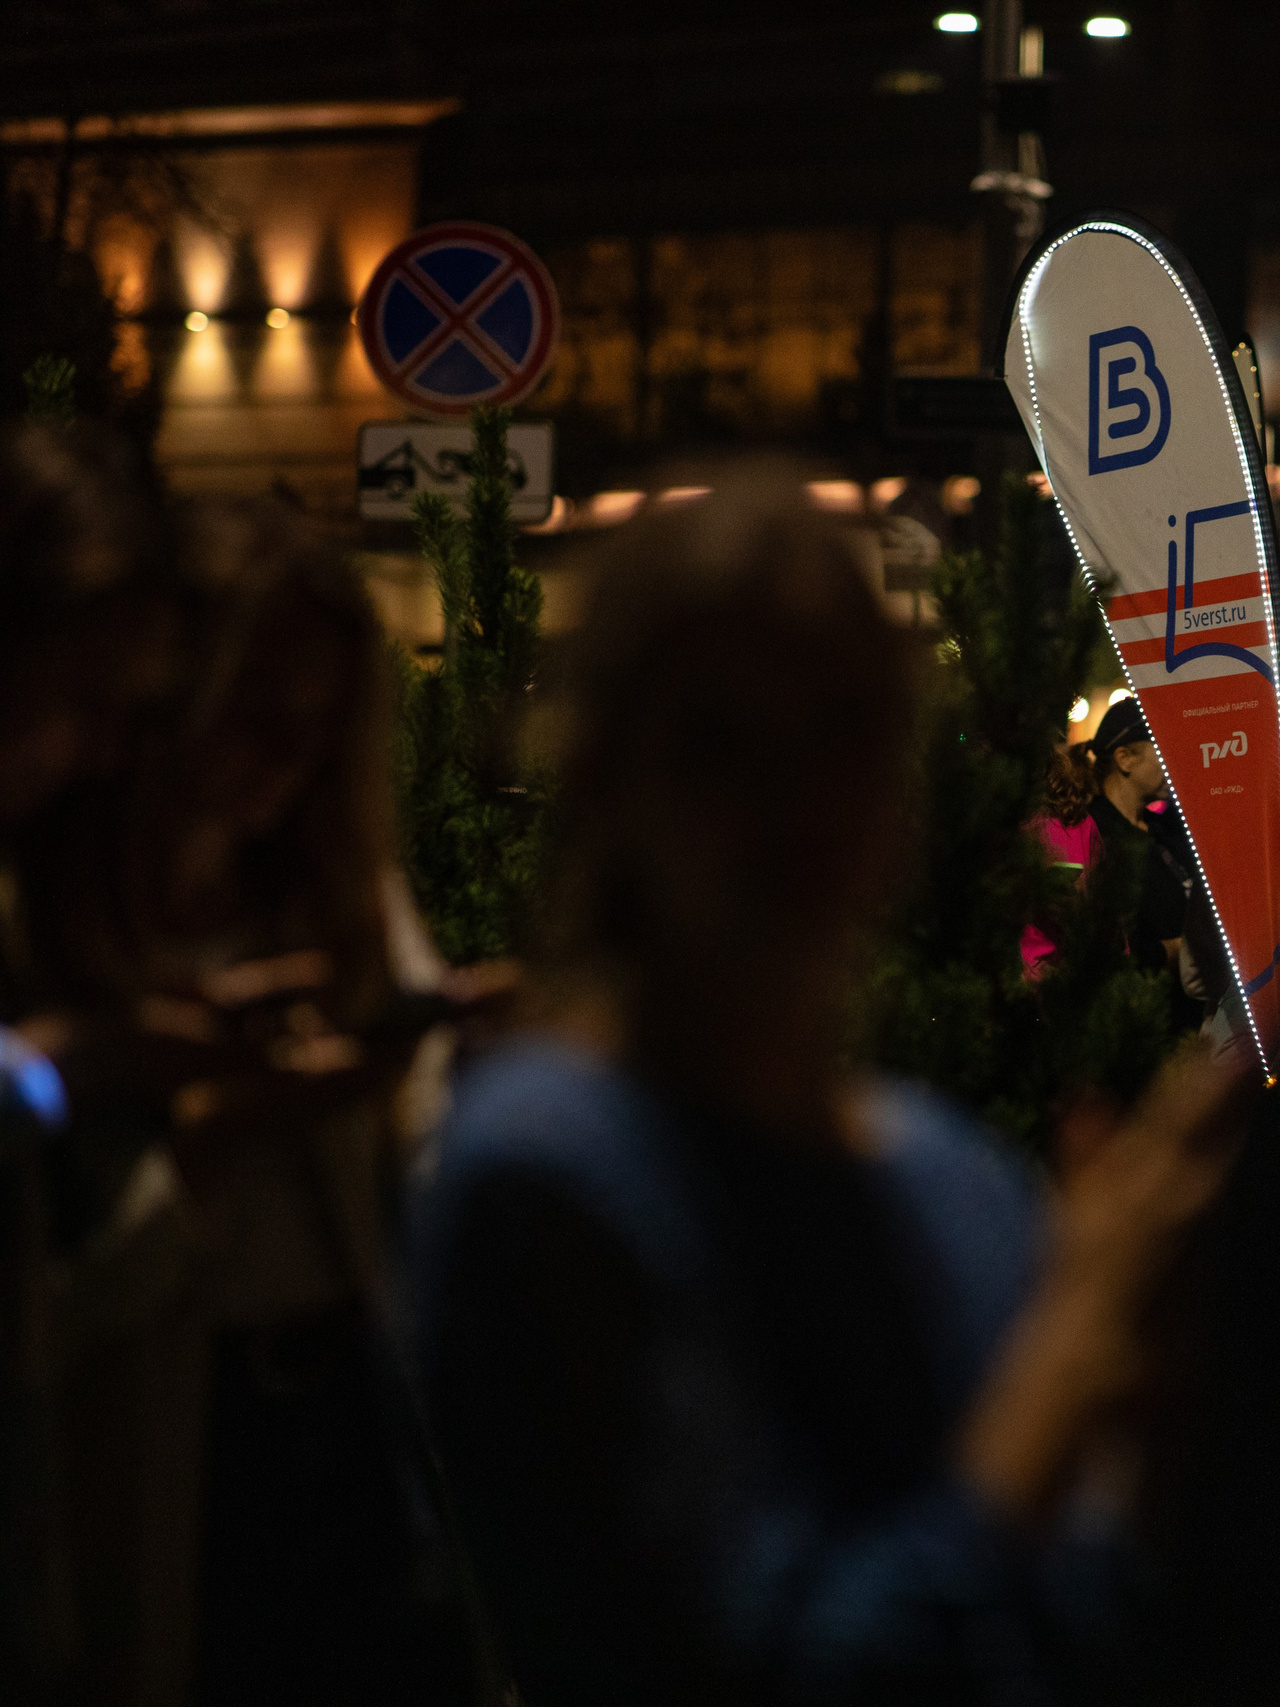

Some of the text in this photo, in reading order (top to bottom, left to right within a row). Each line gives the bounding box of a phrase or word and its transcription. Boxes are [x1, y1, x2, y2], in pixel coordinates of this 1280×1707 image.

[1183, 604, 1247, 630] 5verst.ru
[1182, 700, 1260, 718] ОФИЦИАЛЬНЫЙ ПАРТНЕР
[1210, 786, 1223, 796] ОАО
